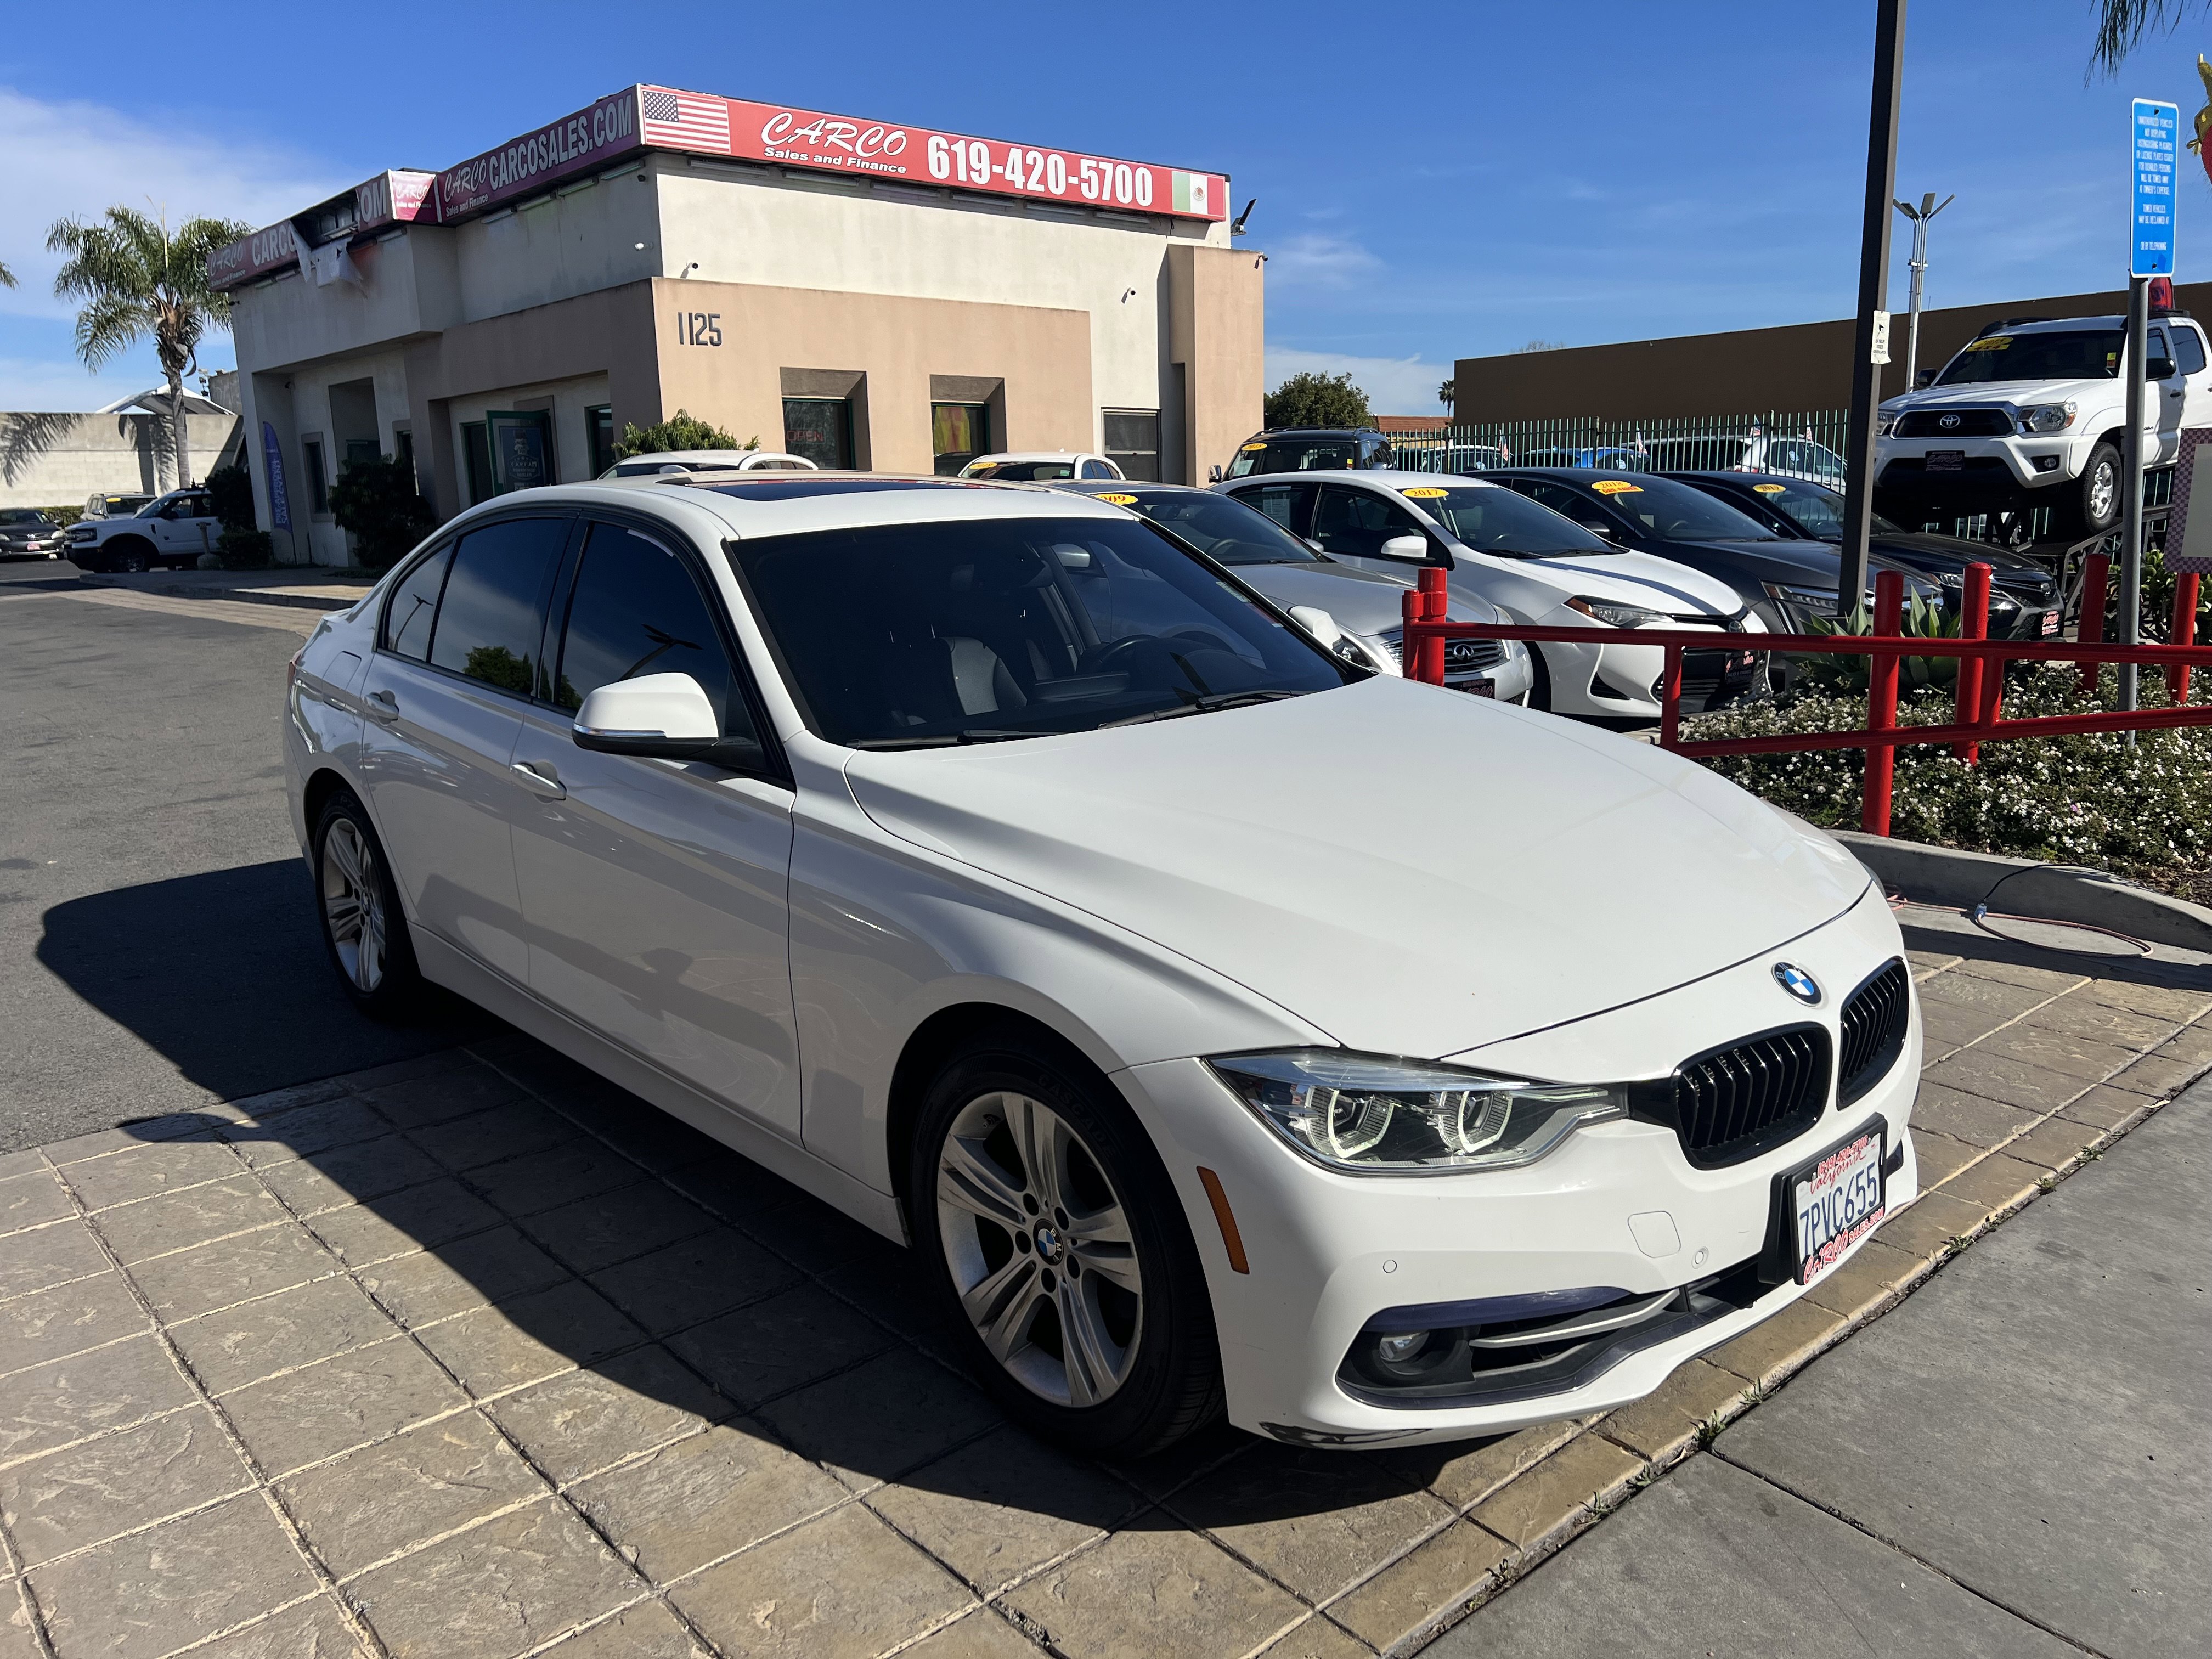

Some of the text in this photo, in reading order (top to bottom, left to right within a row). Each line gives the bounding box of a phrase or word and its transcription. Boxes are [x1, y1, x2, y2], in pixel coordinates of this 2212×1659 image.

[489, 94, 632, 190] CARCOSALES.COM
[761, 112, 907, 157] CARCO
[444, 158, 487, 202] CARCO
[764, 146, 906, 173] Sales and Finance
[927, 135, 1153, 207] 619-420-5700
[446, 193, 488, 217] Sales and Finance
[210, 242, 244, 276] CARCO
[678, 312, 722, 346] 1125
[787, 430, 824, 442] OPEN
[1810, 1150, 1866, 1195] California
[1799, 1162, 1877, 1257] 7PVC655
[1849, 1206, 1884, 1244] SALES.COM
